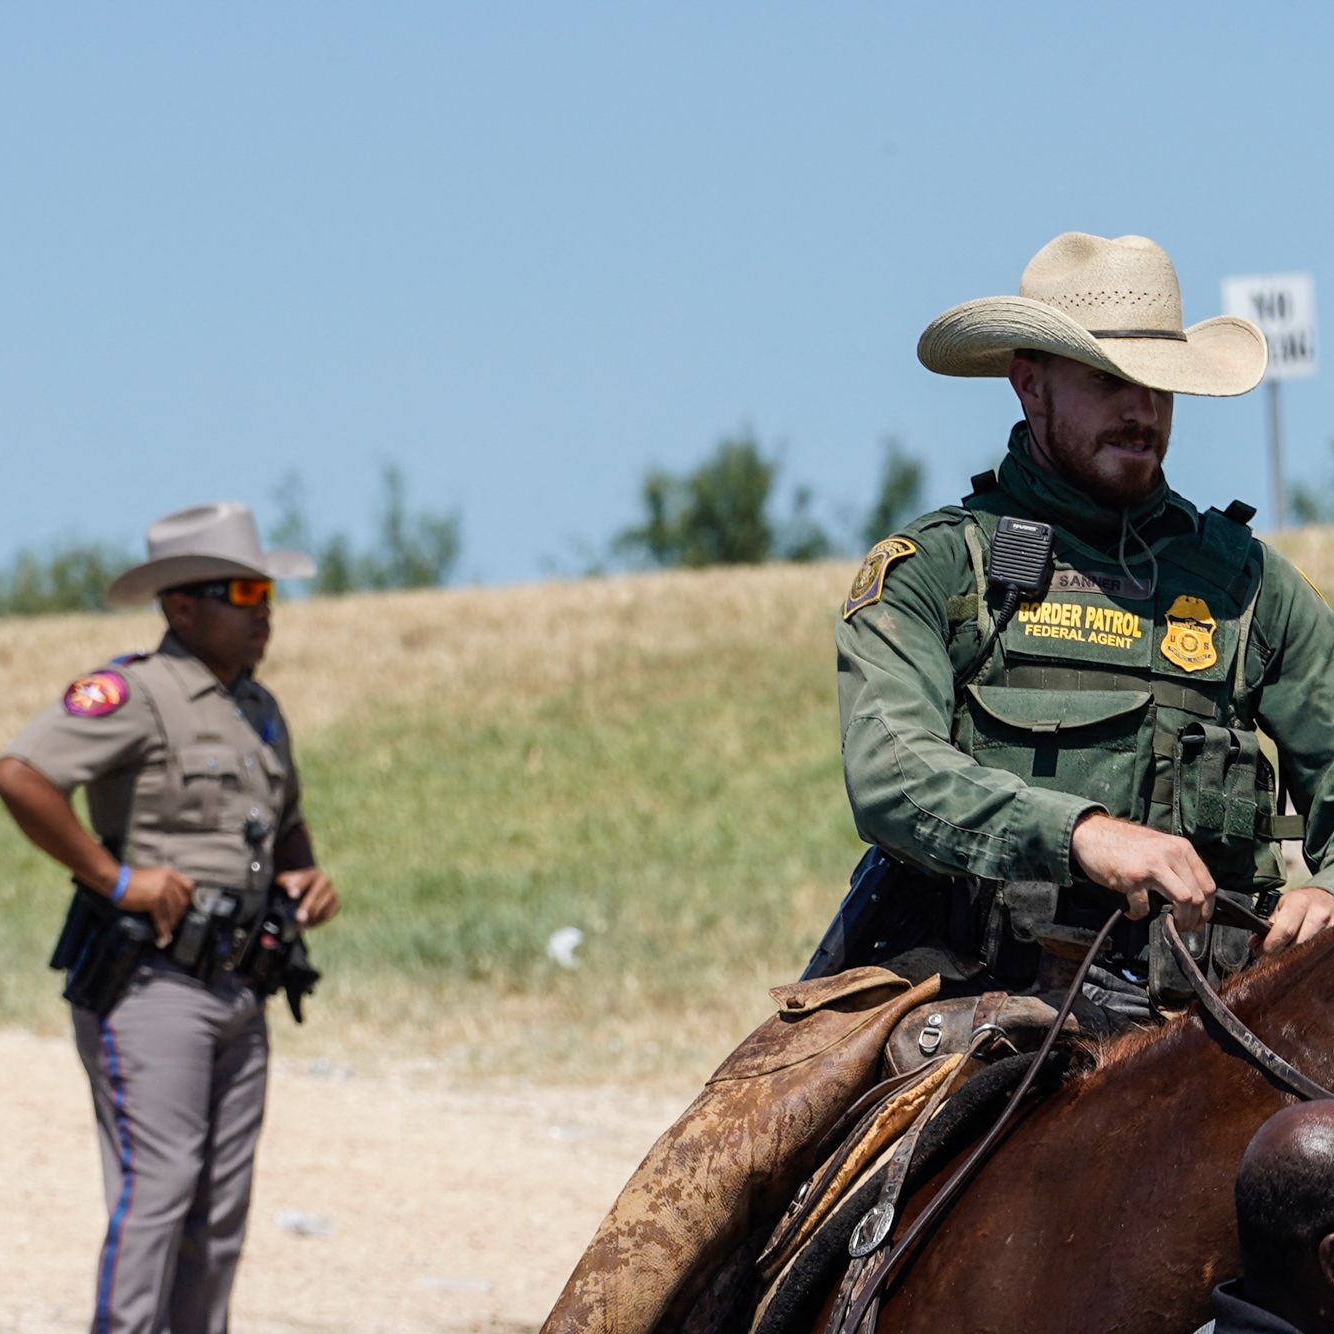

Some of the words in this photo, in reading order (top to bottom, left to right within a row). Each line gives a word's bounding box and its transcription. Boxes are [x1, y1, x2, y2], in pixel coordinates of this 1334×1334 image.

[1059, 575, 1121, 591] SANNER
[1018, 602, 1082, 628] BORDER
[1084, 606, 1142, 638] PATROL
[1025, 624, 1085, 642] FEDERAL
[1088, 632, 1133, 649] AGENT
[1170, 635, 1176, 643] U
